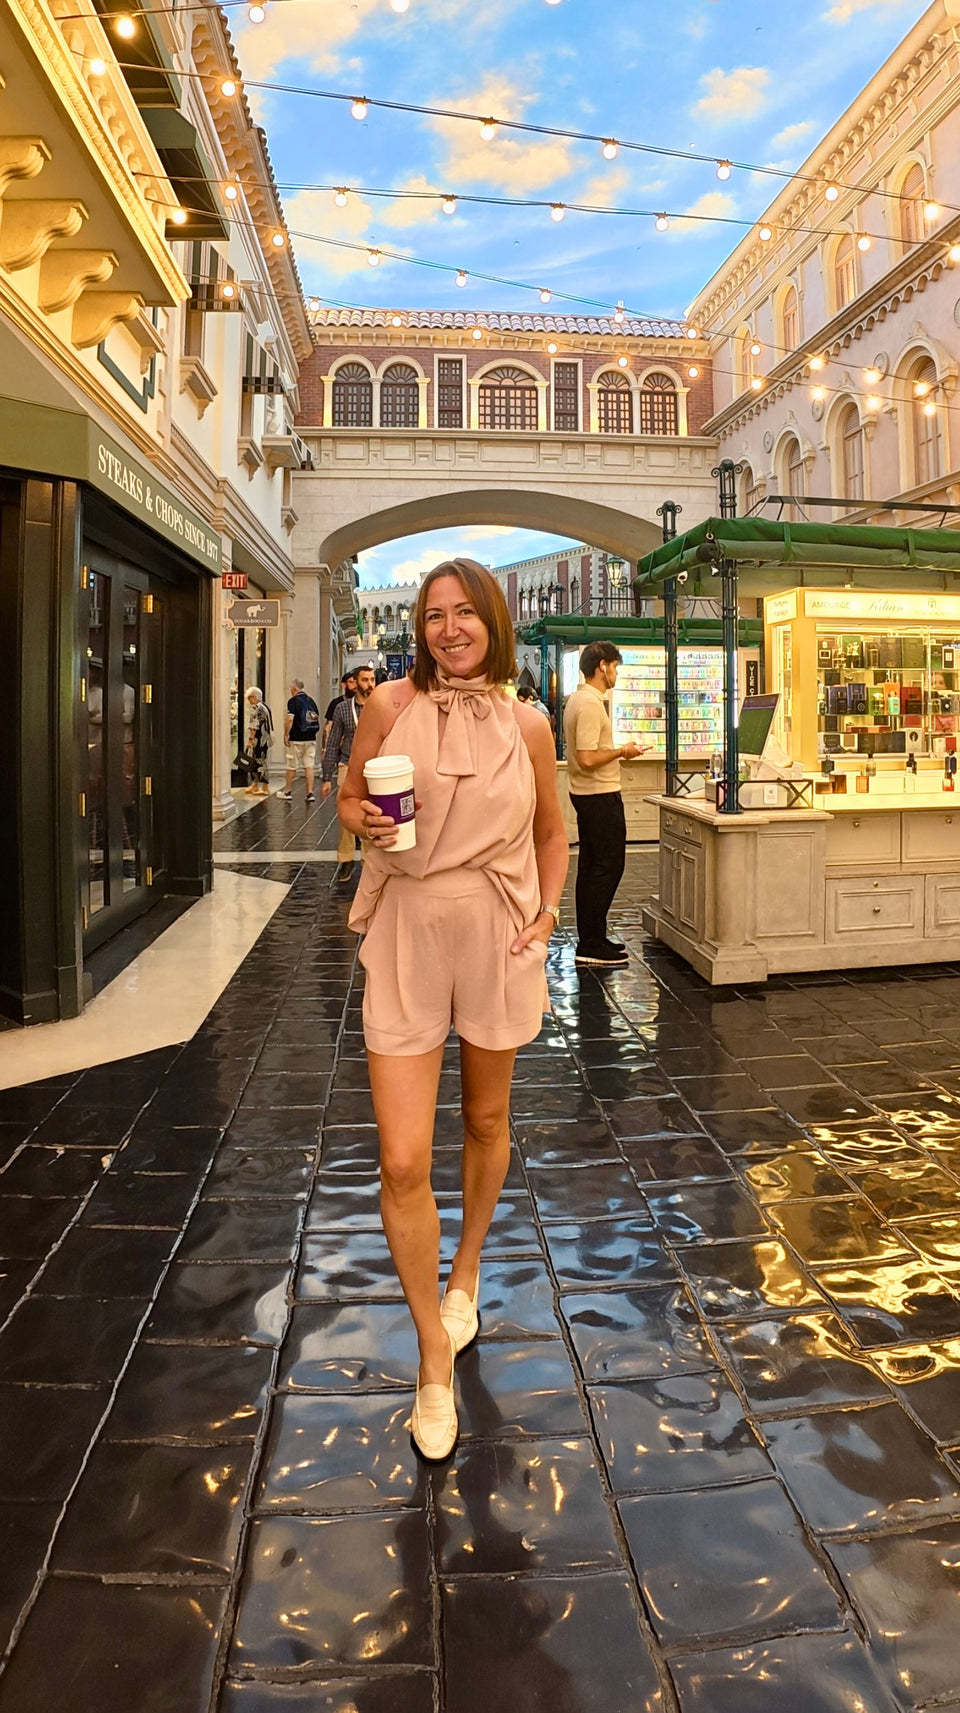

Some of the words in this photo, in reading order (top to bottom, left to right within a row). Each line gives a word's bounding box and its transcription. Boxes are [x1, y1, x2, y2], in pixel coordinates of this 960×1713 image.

[98, 444, 143, 503] STEAKS
[146, 486, 153, 512] &
[155, 495, 184, 536] CHOPS
[184, 519, 206, 553] SINCE
[206, 538, 218, 562] 1977
[226, 574, 246, 588] EXIT
